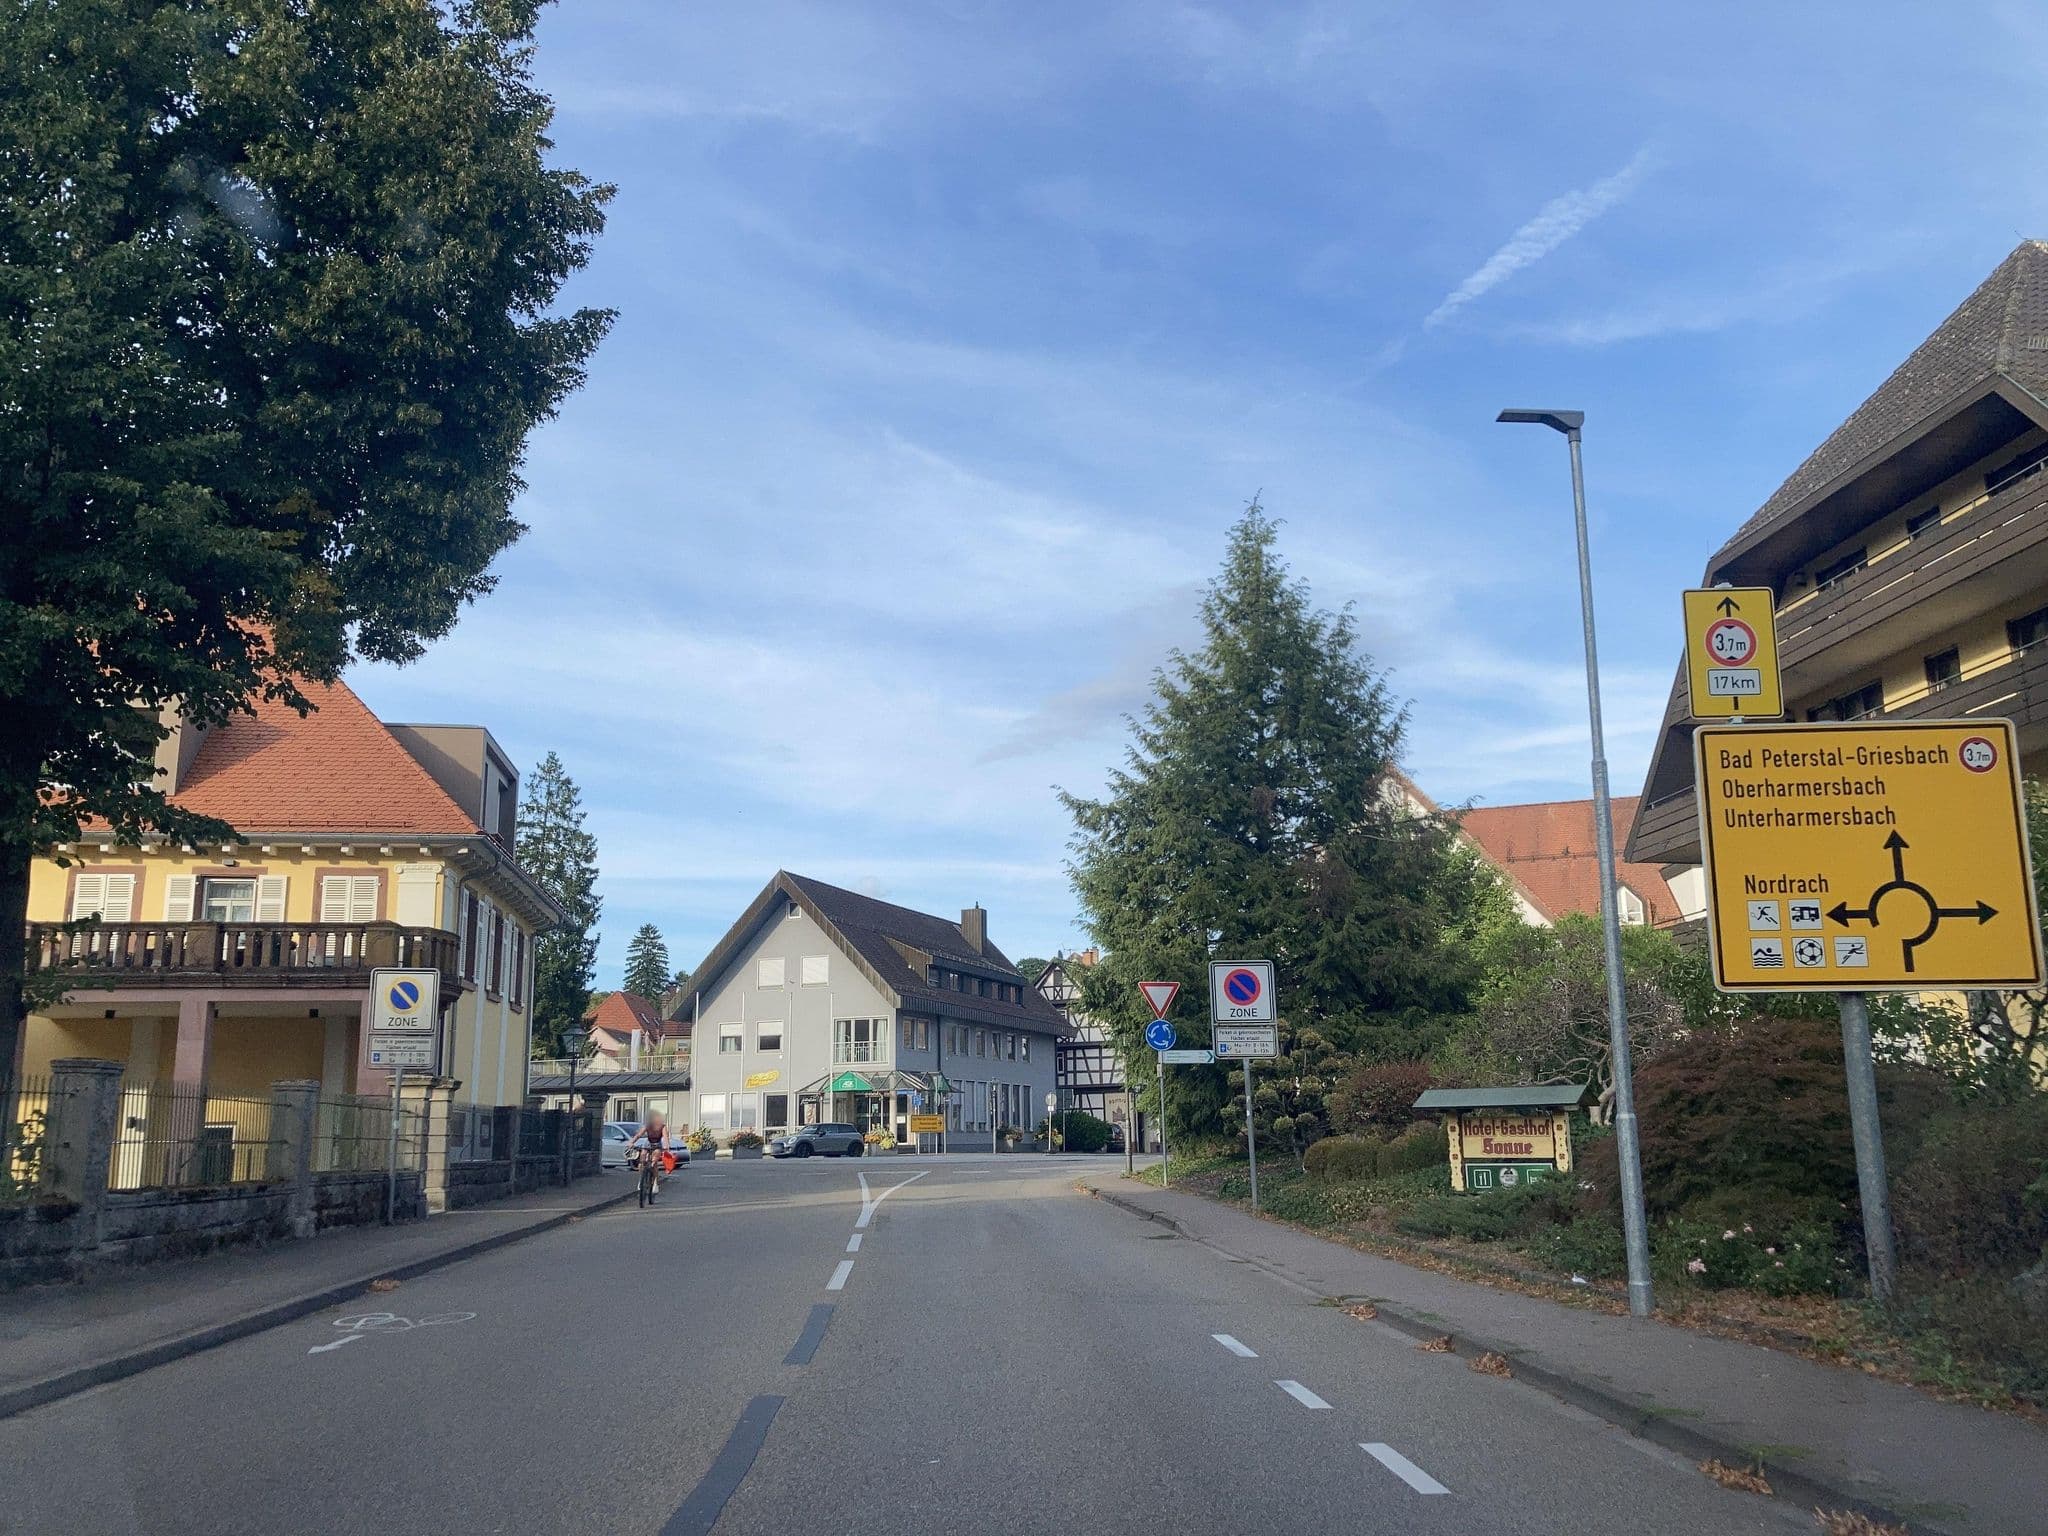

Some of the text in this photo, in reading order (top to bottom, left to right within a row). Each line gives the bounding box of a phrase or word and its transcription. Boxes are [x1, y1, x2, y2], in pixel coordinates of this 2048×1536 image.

[1720, 746, 1949, 769] Bad Peterstal-Griesbach
[1722, 776, 1886, 799] Oberharmersbach
[1725, 806, 1896, 828] Unterharmersbach
[1744, 874, 1829, 895] Nordrach
[388, 1017, 418, 1027] ZONE
[1230, 1008, 1258, 1018] ZONE
[1464, 1119, 1550, 1136] Hotel-Gasthof
[1482, 1137, 1533, 1155] Sonne
